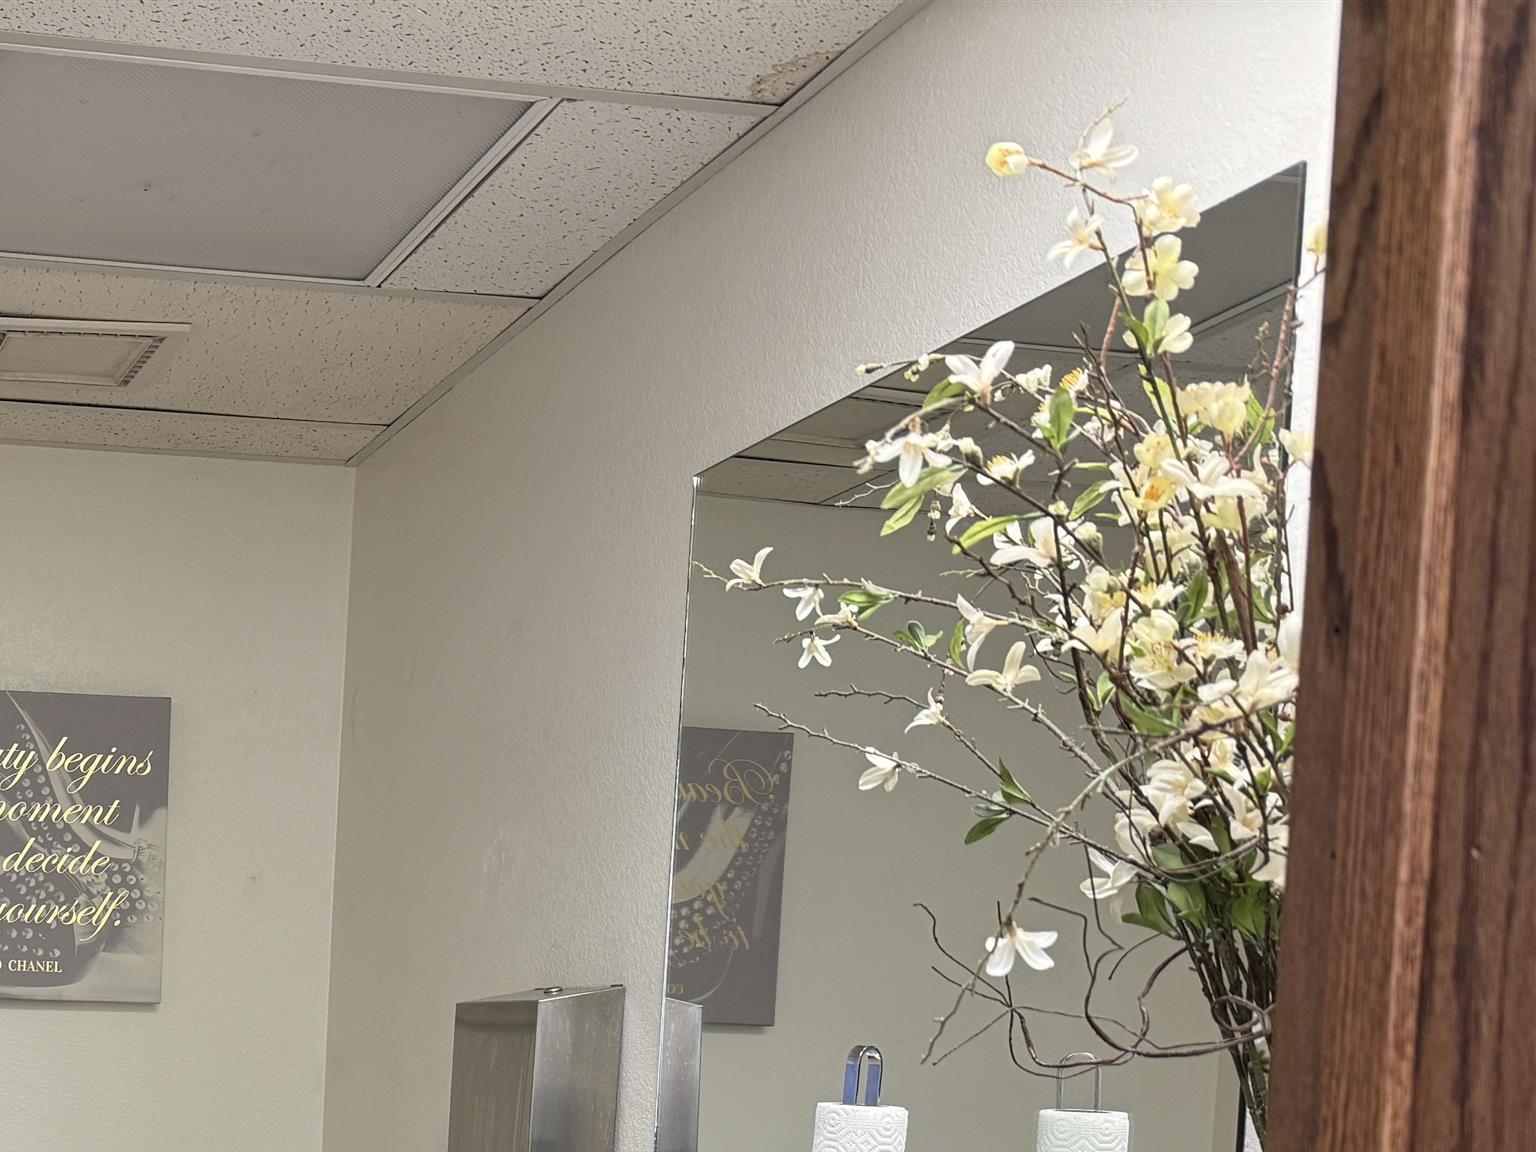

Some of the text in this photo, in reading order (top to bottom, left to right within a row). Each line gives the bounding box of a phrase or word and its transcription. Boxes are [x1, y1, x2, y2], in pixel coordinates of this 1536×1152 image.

[45, 736, 153, 794] begins
[1, 837, 112, 876] decide
[8, 958, 63, 973] CHANEL
